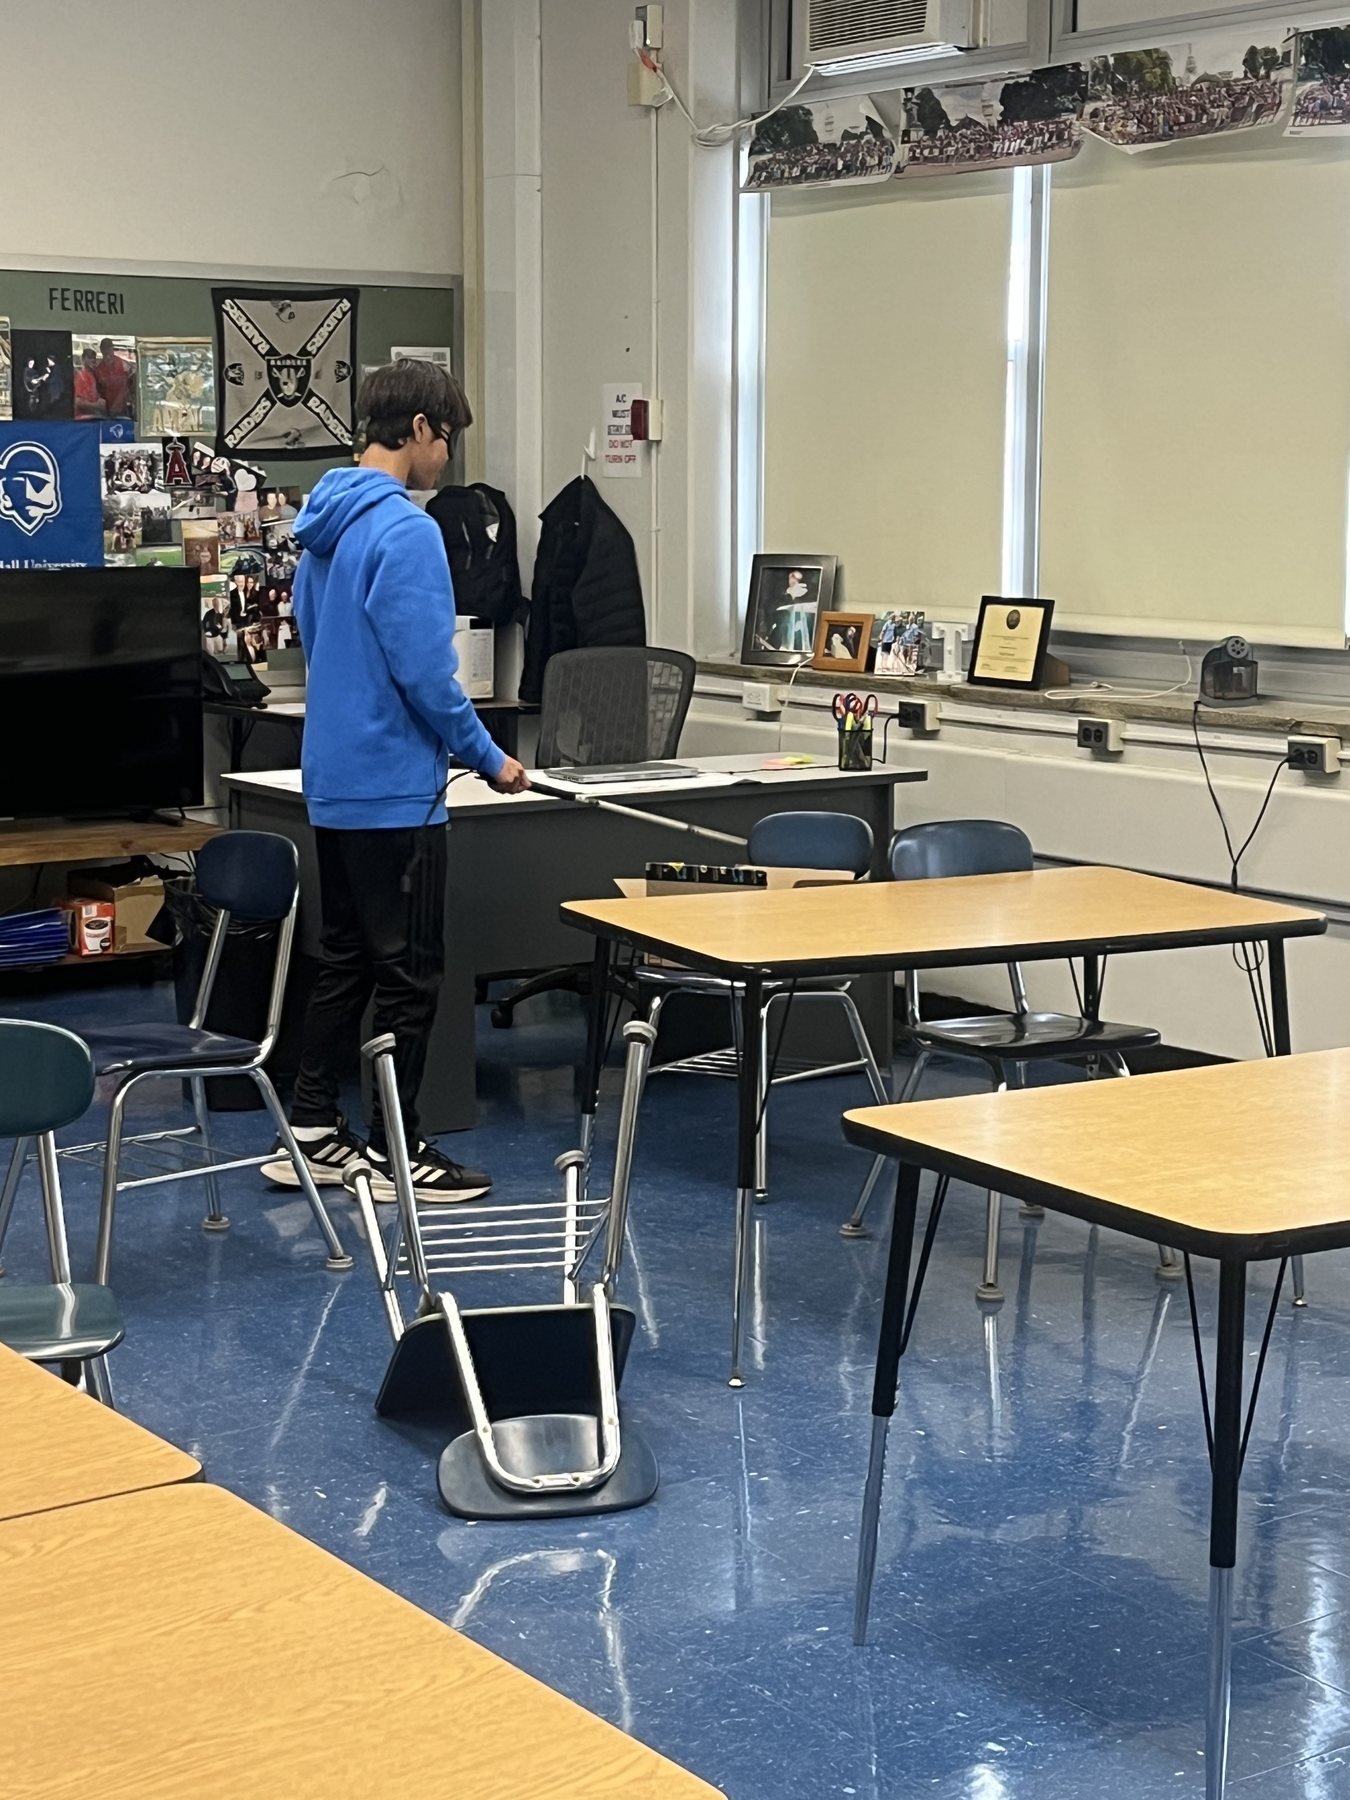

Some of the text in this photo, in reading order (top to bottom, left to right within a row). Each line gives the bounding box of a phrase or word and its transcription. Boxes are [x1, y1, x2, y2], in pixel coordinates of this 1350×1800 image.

[49, 287, 125, 315] FERRERI
[306, 298, 351, 354] RAIDERS
[222, 299, 270, 355] RAIDERS
[224, 397, 272, 448] RAIDERS
[307, 396, 354, 446] RAIDERS
